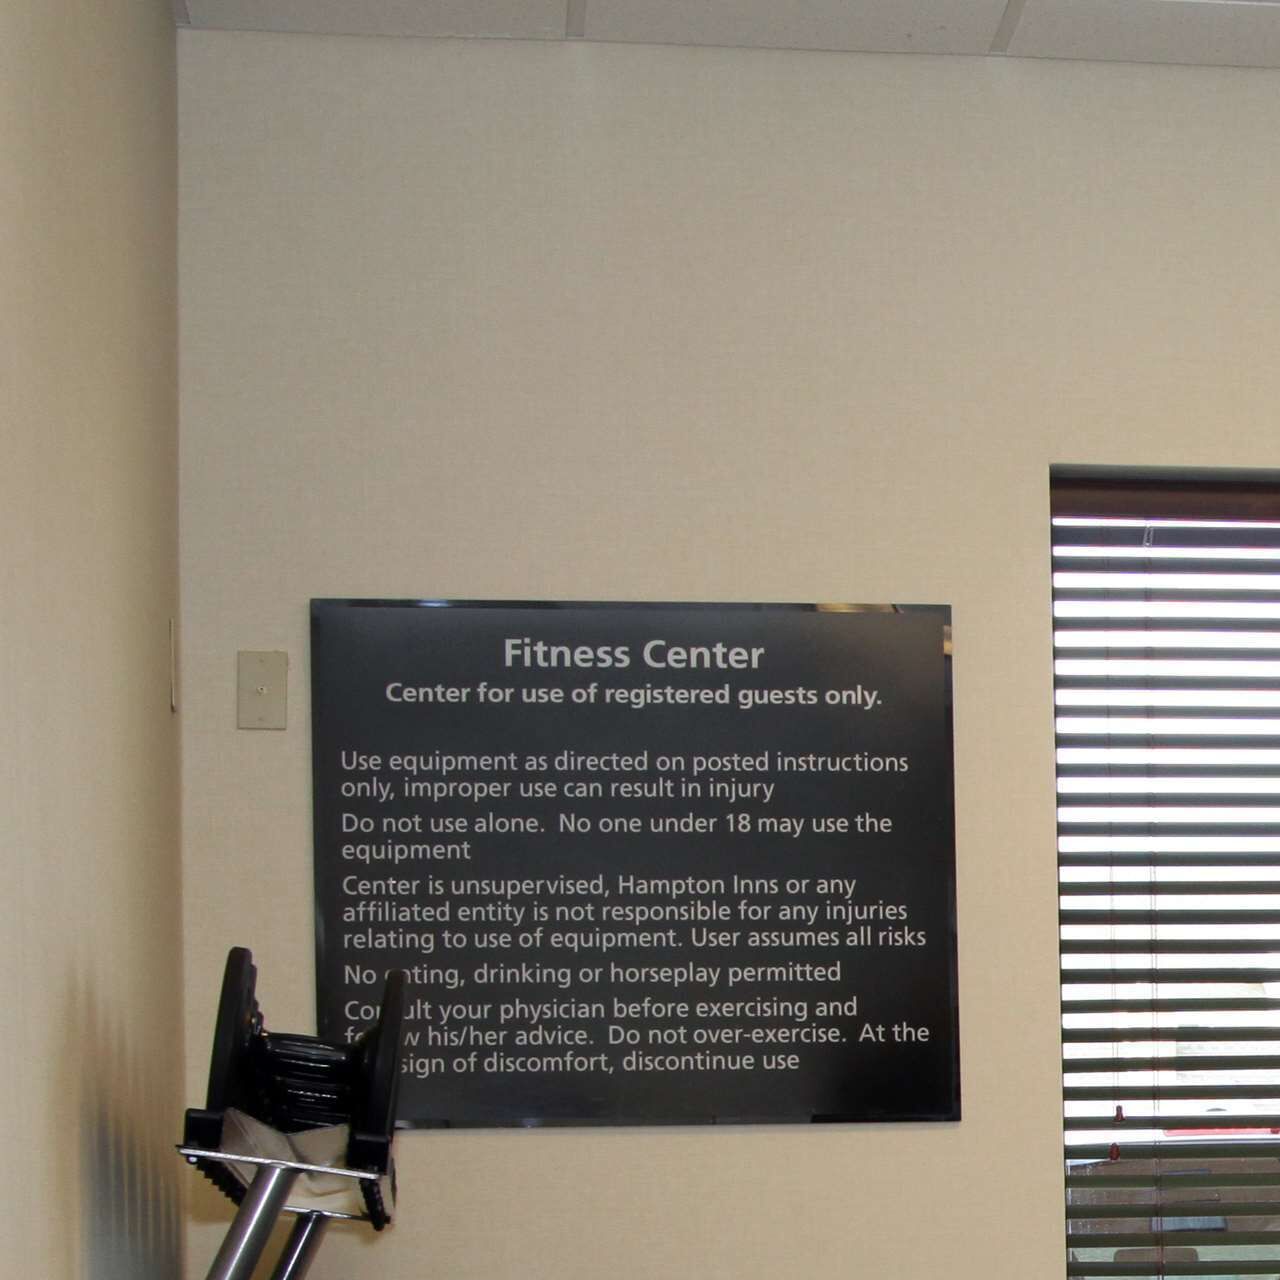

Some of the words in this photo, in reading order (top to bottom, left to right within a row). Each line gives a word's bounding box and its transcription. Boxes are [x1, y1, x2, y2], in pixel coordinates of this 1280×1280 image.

[505, 638, 630, 668] Fitness
[644, 640, 764, 668] Center
[386, 683, 470, 702] Center
[477, 682, 514, 702] for
[522, 688, 564, 702] use
[572, 682, 599, 703] of
[606, 684, 730, 709] registered
[738, 687, 818, 710] guests
[825, 685, 882, 711] only.
[342, 751, 381, 770] Use
[390, 751, 517, 775] equipment
[525, 756, 548, 770] as
[555, 750, 647, 770] directed
[656, 757, 684, 771] on
[694, 751, 768, 776] posted
[778, 752, 908, 771] instructions
[342, 777, 394, 802] only,
[405, 779, 511, 802] improper
[520, 783, 557, 797] use
[564, 783, 602, 797] can
[612, 777, 674, 797] result
[682, 778, 700, 797] in
[710, 778, 774, 802] injury
[343, 814, 374, 832] Do
[383, 815, 422, 832] not
[431, 818, 467, 832] use
[475, 812, 545, 832] alone.
[560, 814, 590, 832] No
[599, 818, 642, 832] one
[651, 813, 717, 832] under
[727, 813, 751, 832] 18
[758, 818, 804, 837] may
[813, 818, 849, 832] use
[855, 813, 892, 832] the
[342, 840, 470, 864] equipment
[343, 876, 420, 895] Center
[429, 875, 443, 894] is
[452, 874, 610, 899] unsupervised,
[619, 875, 724, 899] Hampton
[734, 875, 778, 893] Inns
[786, 880, 810, 893] or
[817, 879, 856, 899] any
[344, 901, 450, 921] affiliated
[458, 902, 525, 926] entity
[534, 902, 549, 920] is
[556, 904, 594, 920] not
[603, 900, 730, 925] responsible
[738, 900, 771, 920] for
[779, 906, 819, 926] any
[826, 900, 908, 925] injuries
[344, 928, 434, 953] relating
[442, 931, 467, 948] to
[475, 933, 511, 948] use
[519, 927, 545, 948] of
[551, 928, 682, 952] equipment.
[692, 928, 740, 946] User
[748, 932, 839, 946] assumes
[846, 926, 871, 946] all
[879, 926, 926, 945] risks
[345, 965, 376, 984] No
[474, 963, 570, 988] drinking
[579, 968, 604, 982] or
[611, 962, 720, 987] horseplay
[729, 961, 841, 986] permitted
[345, 999, 432, 1020] Coult
[440, 1005, 493, 1024] your
[501, 999, 604, 1024] physician
[614, 997, 689, 1017] before
[696, 997, 807, 1021] exercising
[816, 996, 857, 1016] and
[429, 1026, 507, 1045] his/her
[515, 1025, 594, 1045] advice.
[609, 1026, 640, 1044] Do
[649, 1027, 687, 1044] not
[694, 1023, 846, 1043] over-exercise.
[859, 1024, 886, 1042] At
[892, 1022, 929, 1042] the
[401, 1053, 444, 1078] sign
[453, 1052, 479, 1072] of
[484, 1051, 613, 1074] discomfort,
[623, 1051, 754, 1071] discontinue
[764, 1055, 799, 1069] use
